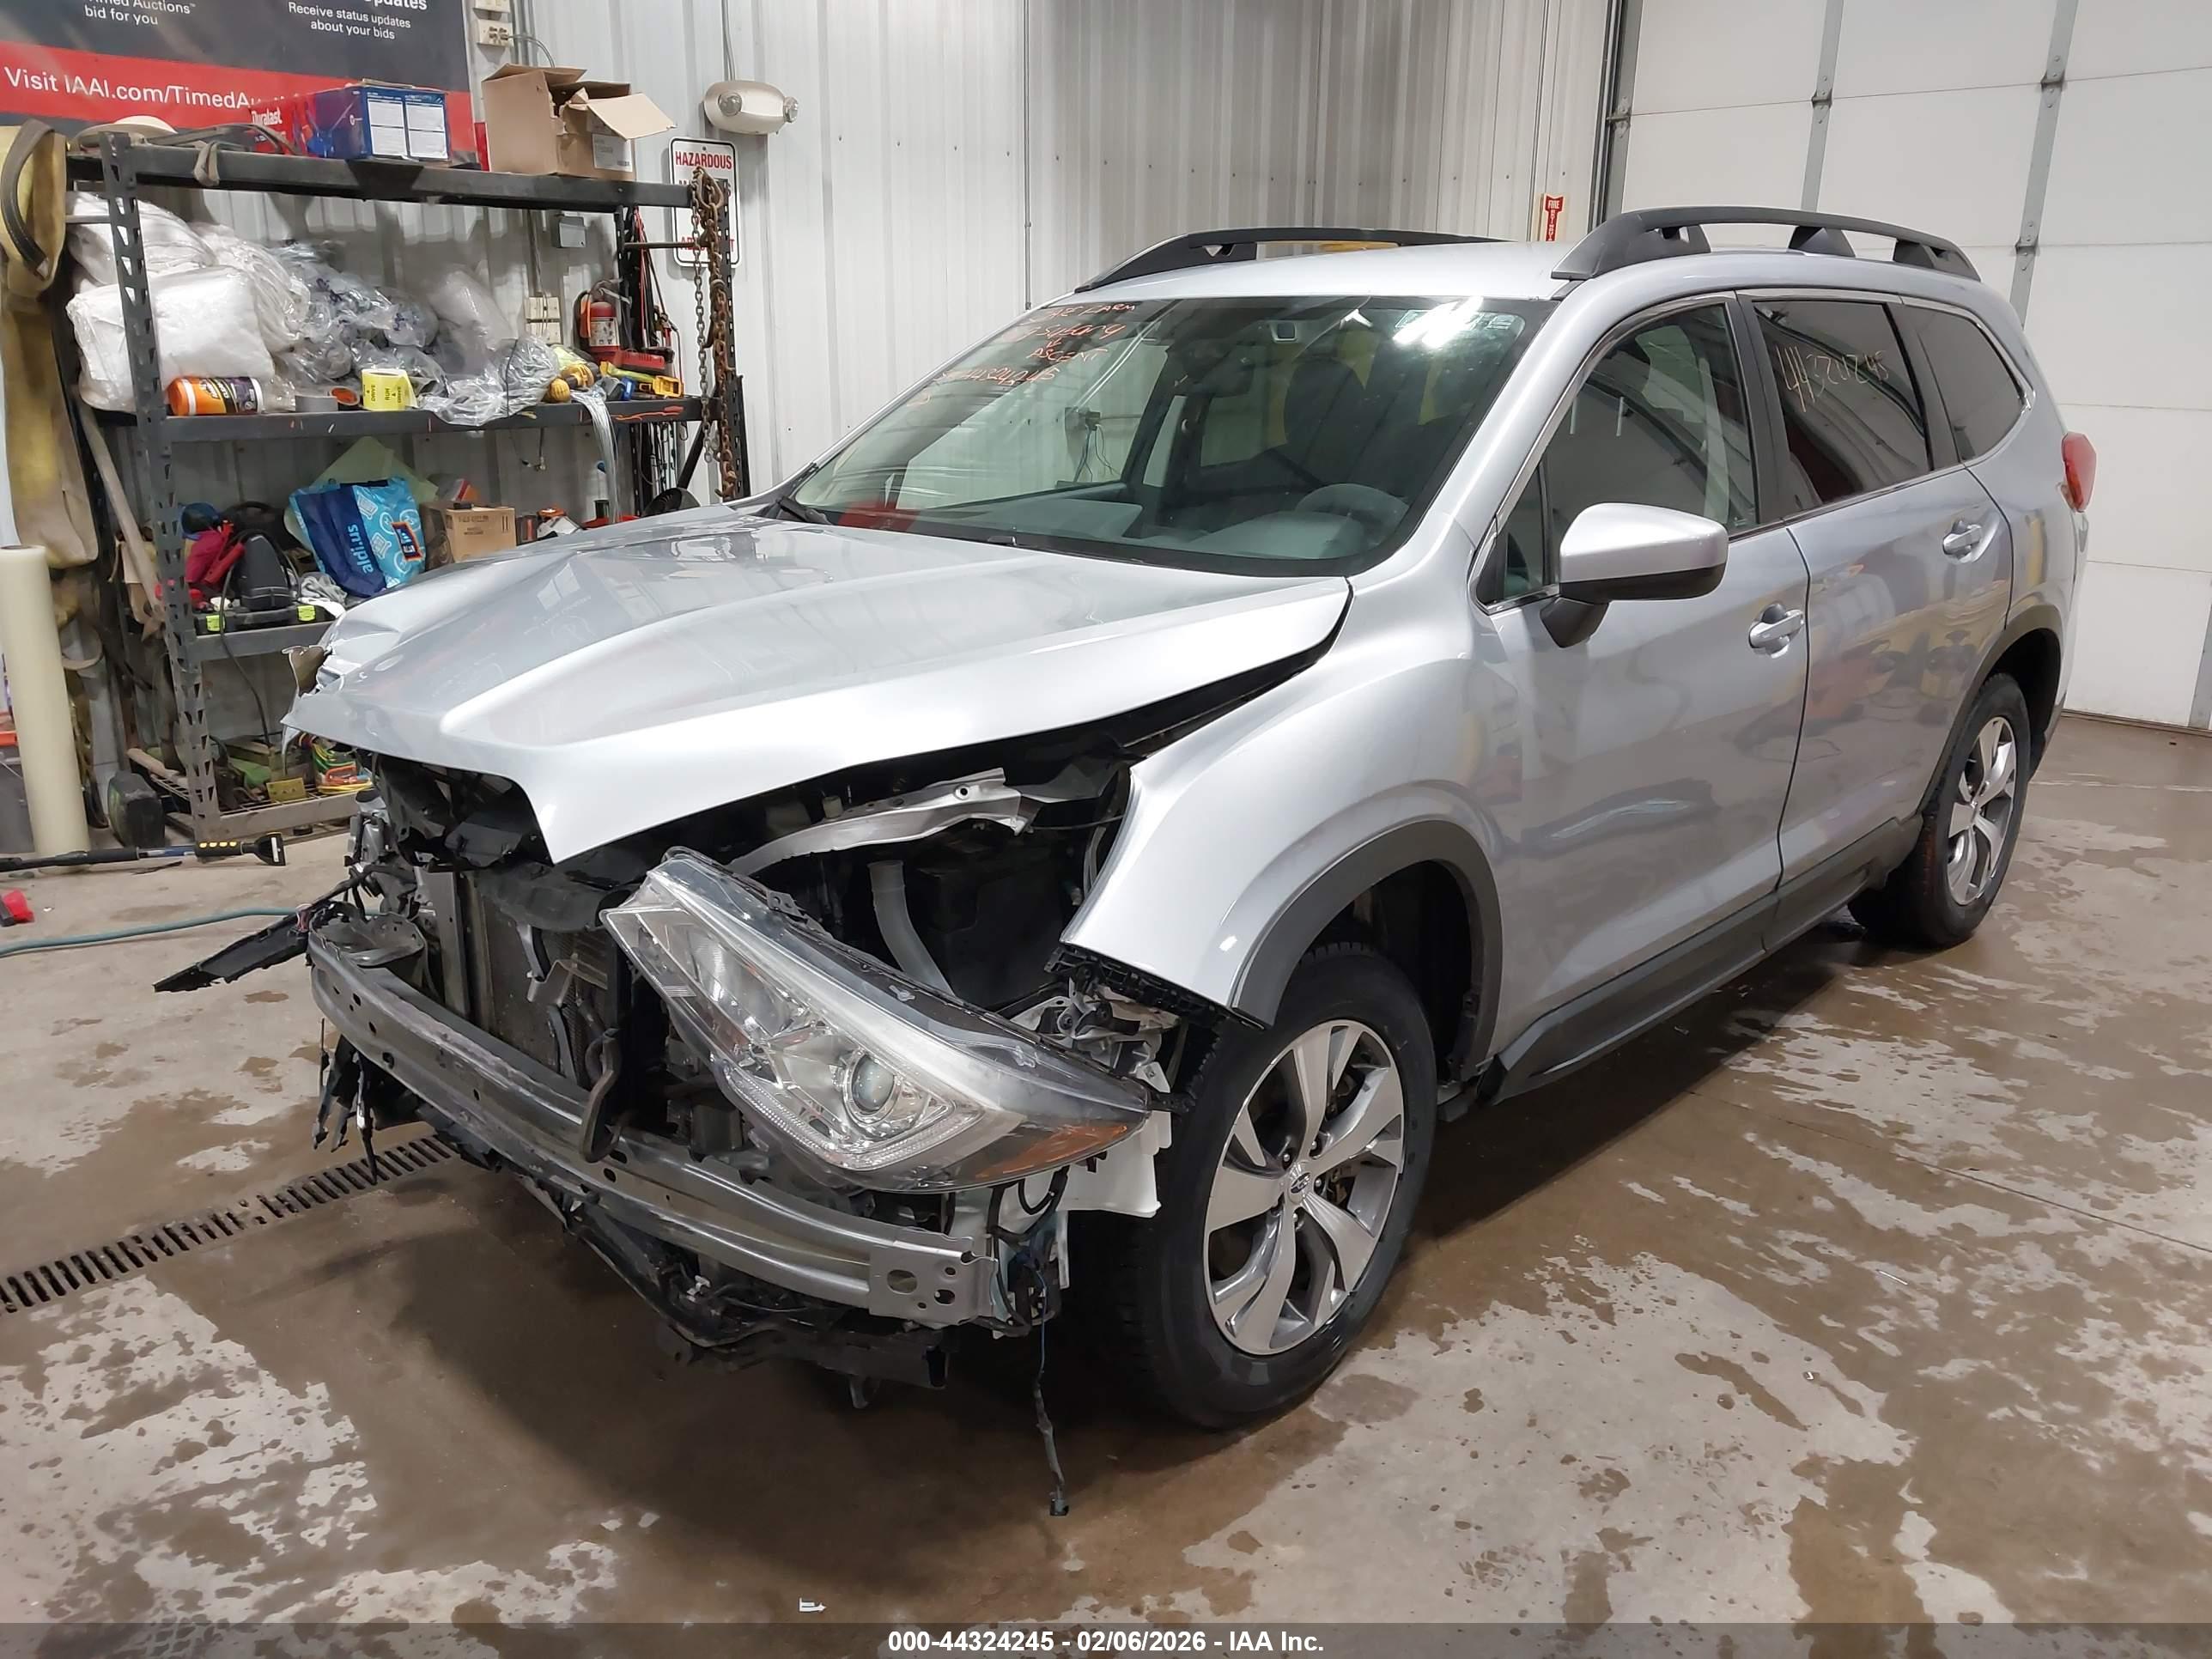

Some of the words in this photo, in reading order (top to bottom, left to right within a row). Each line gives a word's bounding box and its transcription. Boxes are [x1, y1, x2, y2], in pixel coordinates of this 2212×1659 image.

[84, 4, 106, 19] bid
[110, 9, 130, 21] for
[133, 13, 159, 26] you
[288, 2, 333, 18] Receive
[336, 9, 369, 22] status
[371, 14, 411, 28] updates
[310, 19, 343, 33] about
[345, 24, 371, 36] your
[373, 27, 395, 40] bids
[3, 66, 59, 92] Visit
[64, 75, 299, 109] IAAI.com/TimedA
[675, 150, 732, 170] HAZARDOUS
[1547, 200, 1560, 210] FIRE
[348, 524, 374, 574] aldi.us
